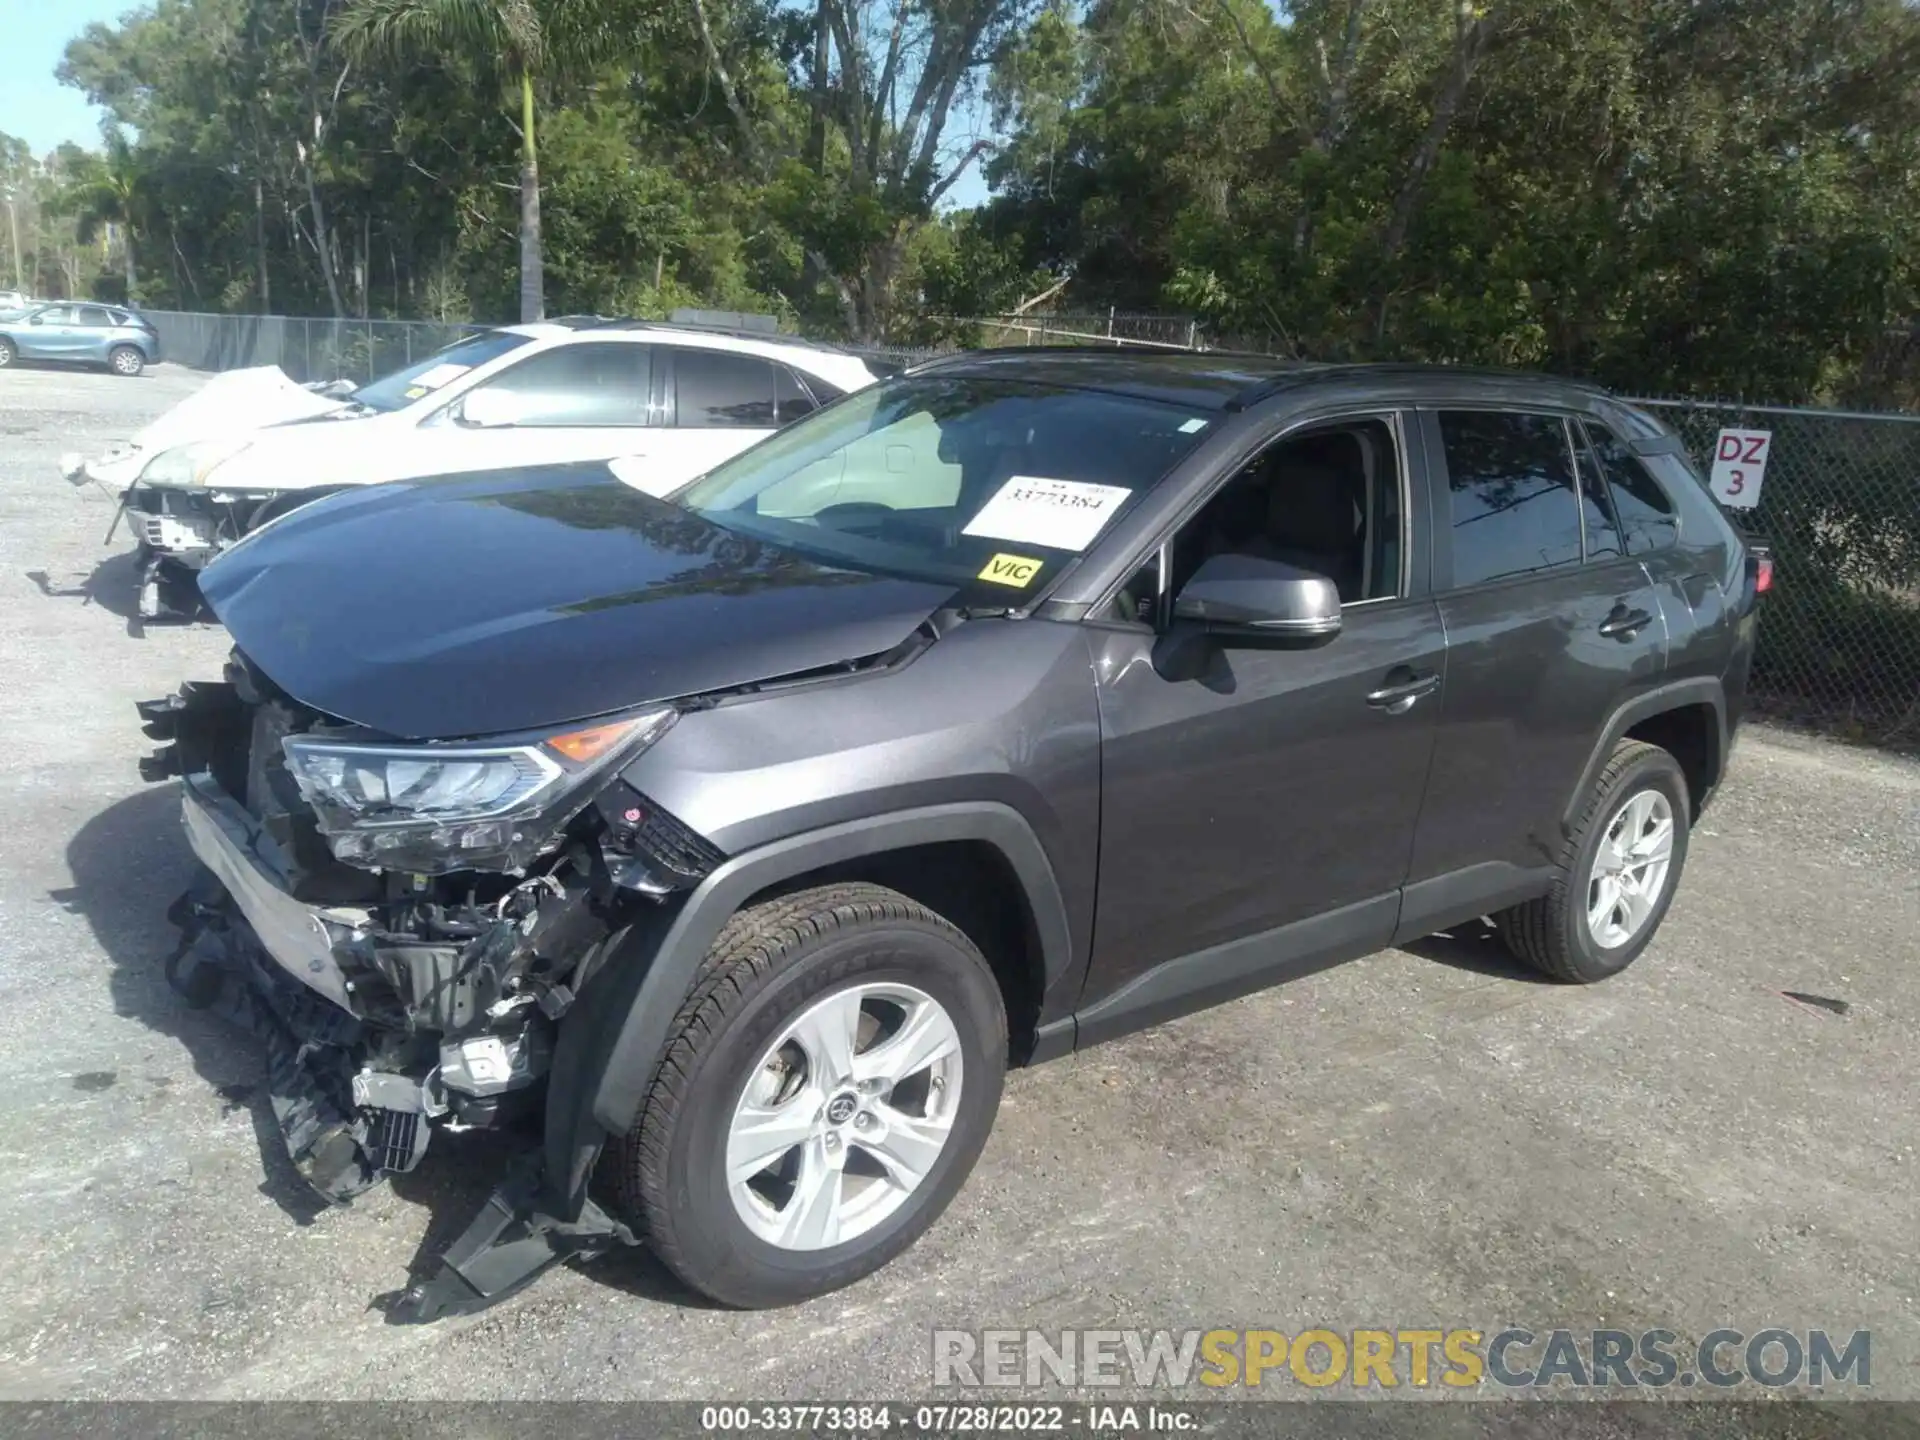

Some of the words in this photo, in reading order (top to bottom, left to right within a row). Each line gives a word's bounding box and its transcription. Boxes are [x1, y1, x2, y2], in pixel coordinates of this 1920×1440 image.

[1718, 435, 1767, 465] DZ
[1726, 470, 1745, 495] 3
[992, 559, 1033, 580] VIC
